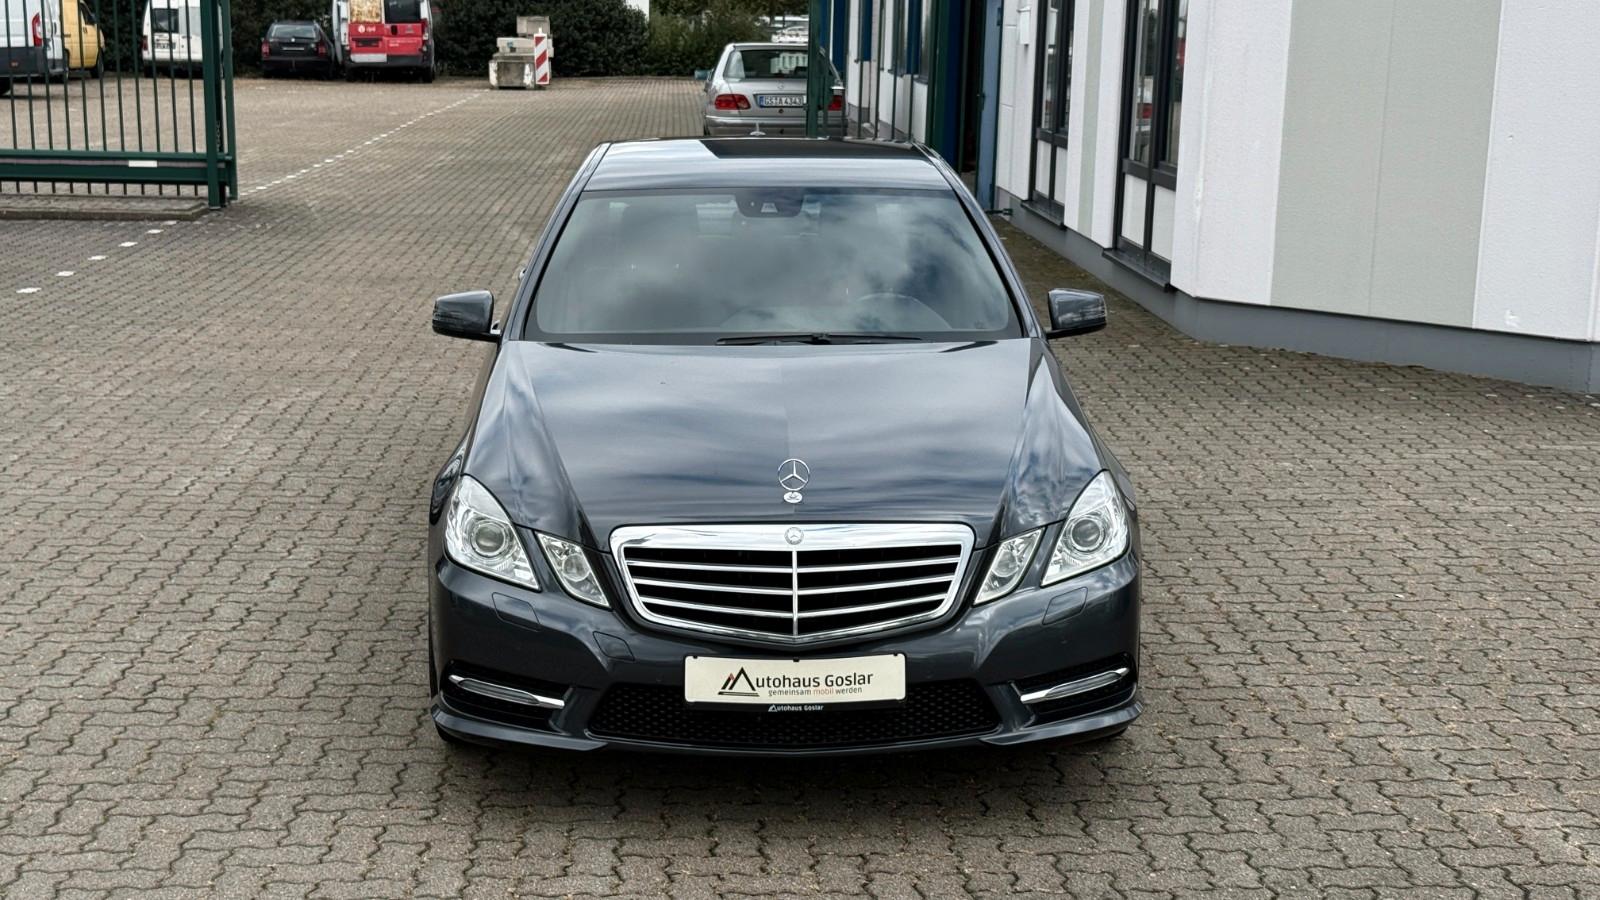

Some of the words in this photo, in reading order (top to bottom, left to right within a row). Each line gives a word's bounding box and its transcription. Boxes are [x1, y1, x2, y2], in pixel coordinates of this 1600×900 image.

[722, 667, 820, 692] Autohaus
[825, 672, 874, 687] Goslar
[768, 689, 812, 697] gemeinsam
[813, 688, 834, 696] mobil
[836, 686, 863, 695] werden
[768, 704, 802, 712] Autohaus
